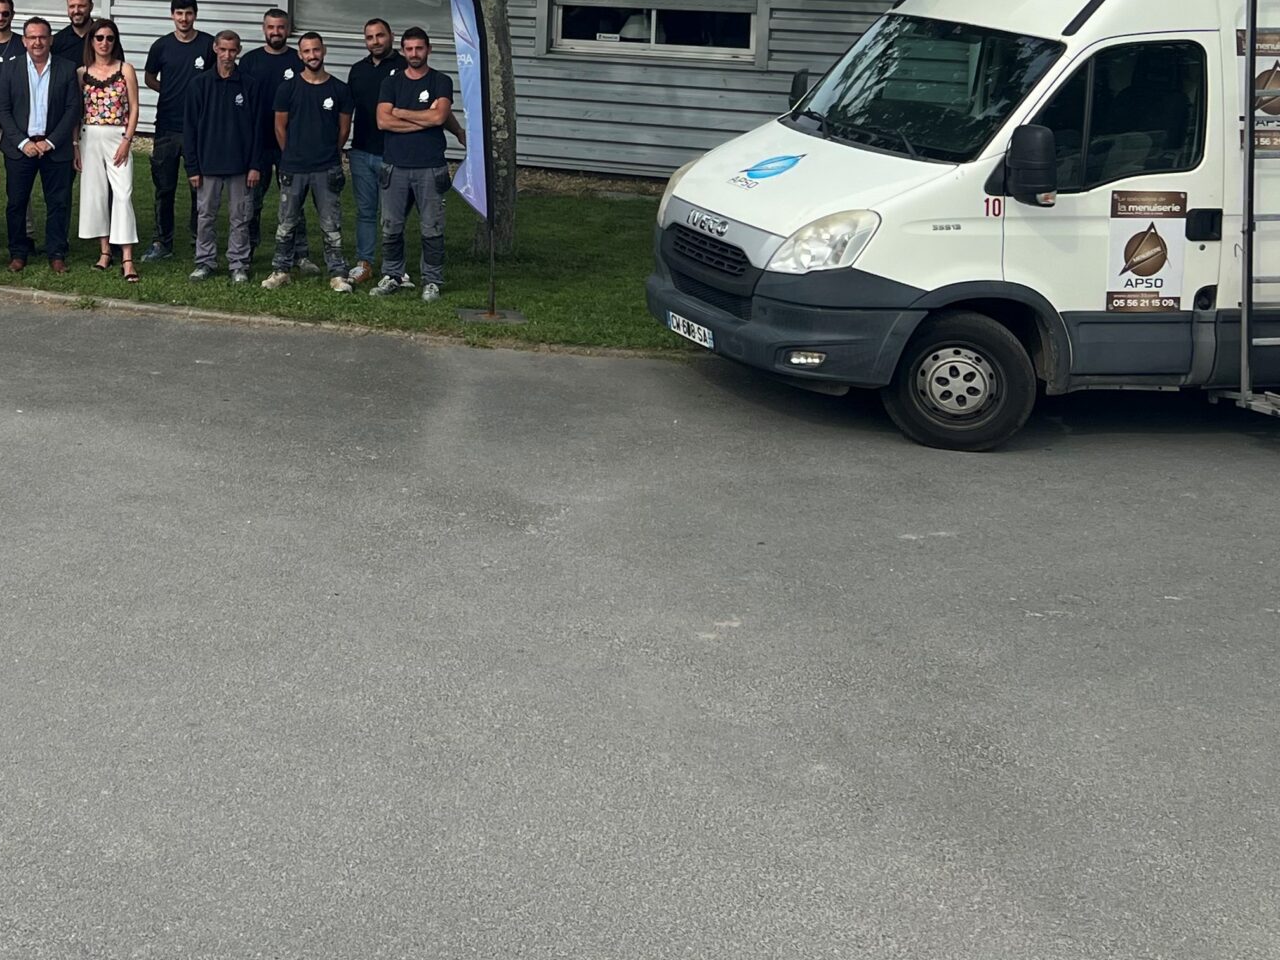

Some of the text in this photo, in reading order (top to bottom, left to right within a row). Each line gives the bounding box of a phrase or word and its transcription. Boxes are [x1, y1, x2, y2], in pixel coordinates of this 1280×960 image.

[984, 197, 1002, 217] 10
[1128, 203, 1181, 212] menuiserie
[686, 209, 729, 237] IVECO
[1124, 278, 1163, 289] APSO
[1112, 299, 1175, 307] 05 56 21 15 09
